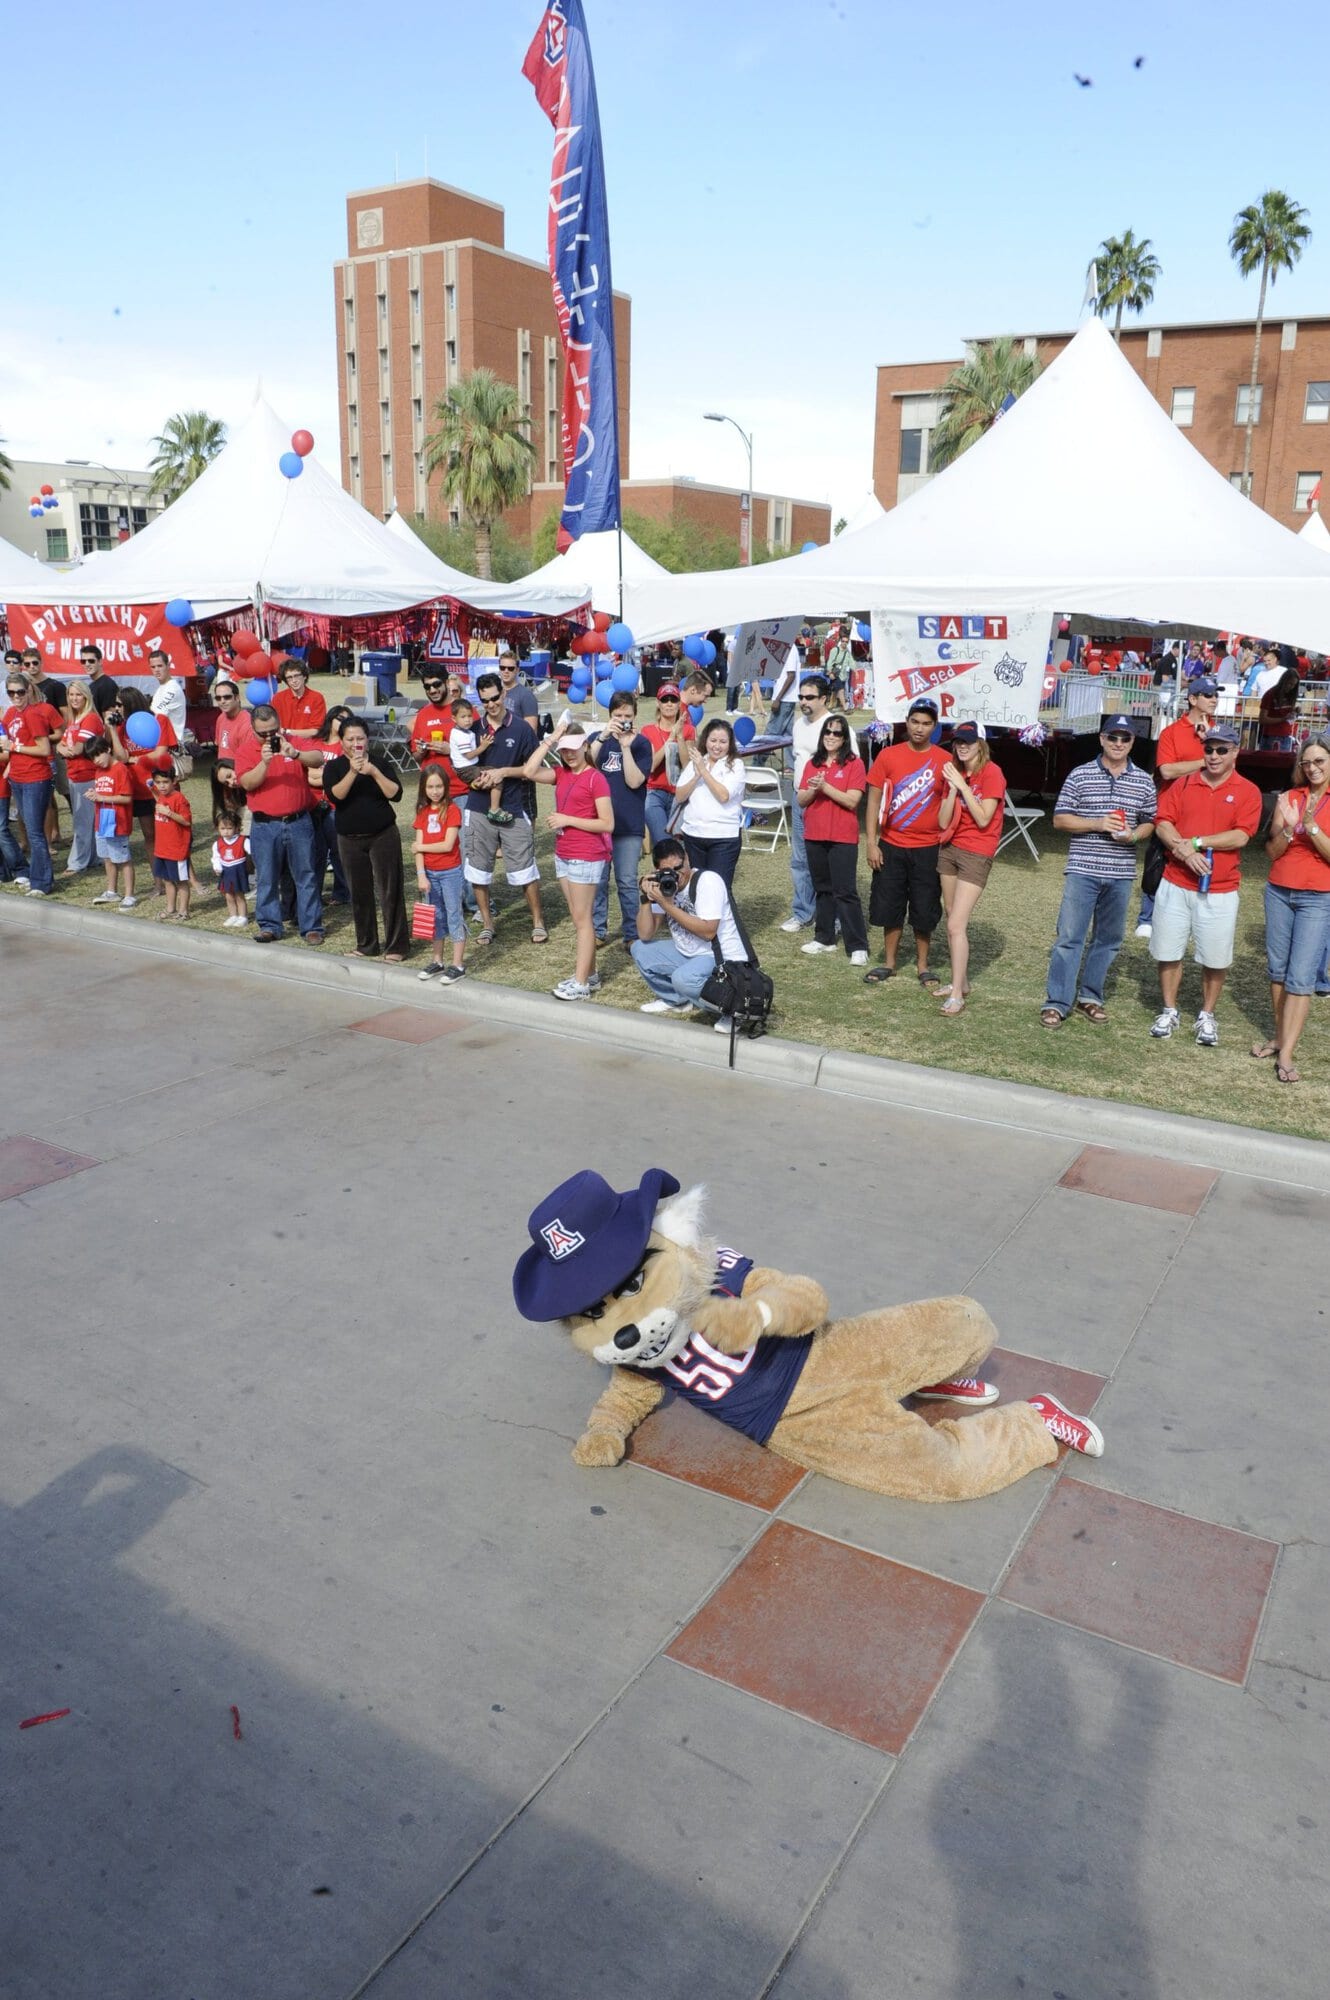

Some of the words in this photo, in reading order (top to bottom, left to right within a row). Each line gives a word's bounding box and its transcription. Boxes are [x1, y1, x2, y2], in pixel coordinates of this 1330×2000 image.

[24, 605, 67, 649] APPY
[922, 618, 1004, 638] SALT
[938, 642, 991, 661] Center
[908, 666, 956, 695] Aged
[972, 672, 992, 694] to
[540, 1218, 586, 1261] A
